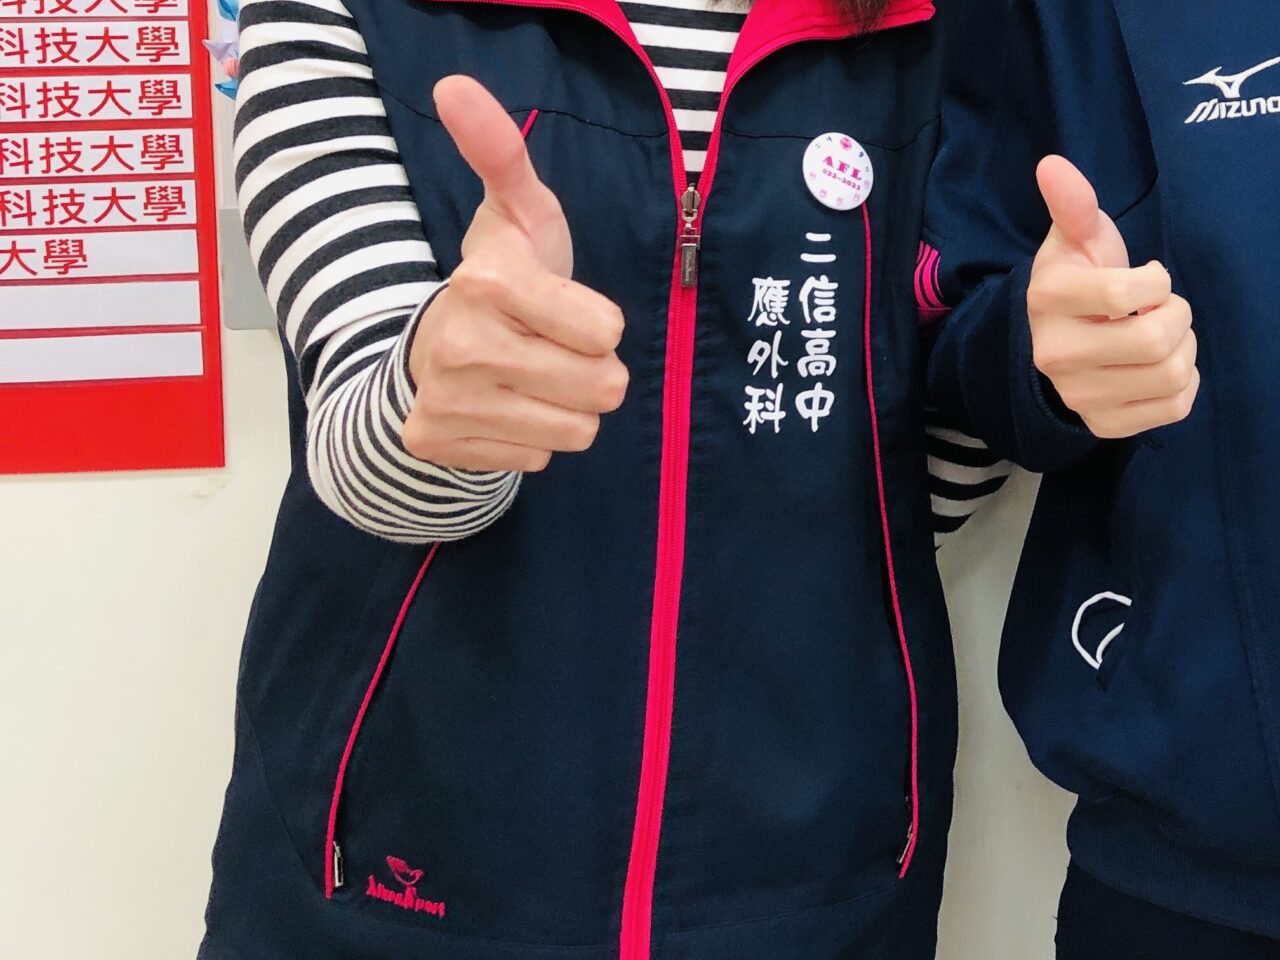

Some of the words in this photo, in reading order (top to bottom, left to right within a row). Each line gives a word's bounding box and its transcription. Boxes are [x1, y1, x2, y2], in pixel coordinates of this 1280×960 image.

[0, 134, 184, 173] 科技大學
[823, 156, 862, 181] AFL
[0, 185, 187, 225] 科技大學
[0, 239, 87, 276] 大學
[795, 232, 839, 432] 二信高中
[743, 276, 791, 434] 應外科
